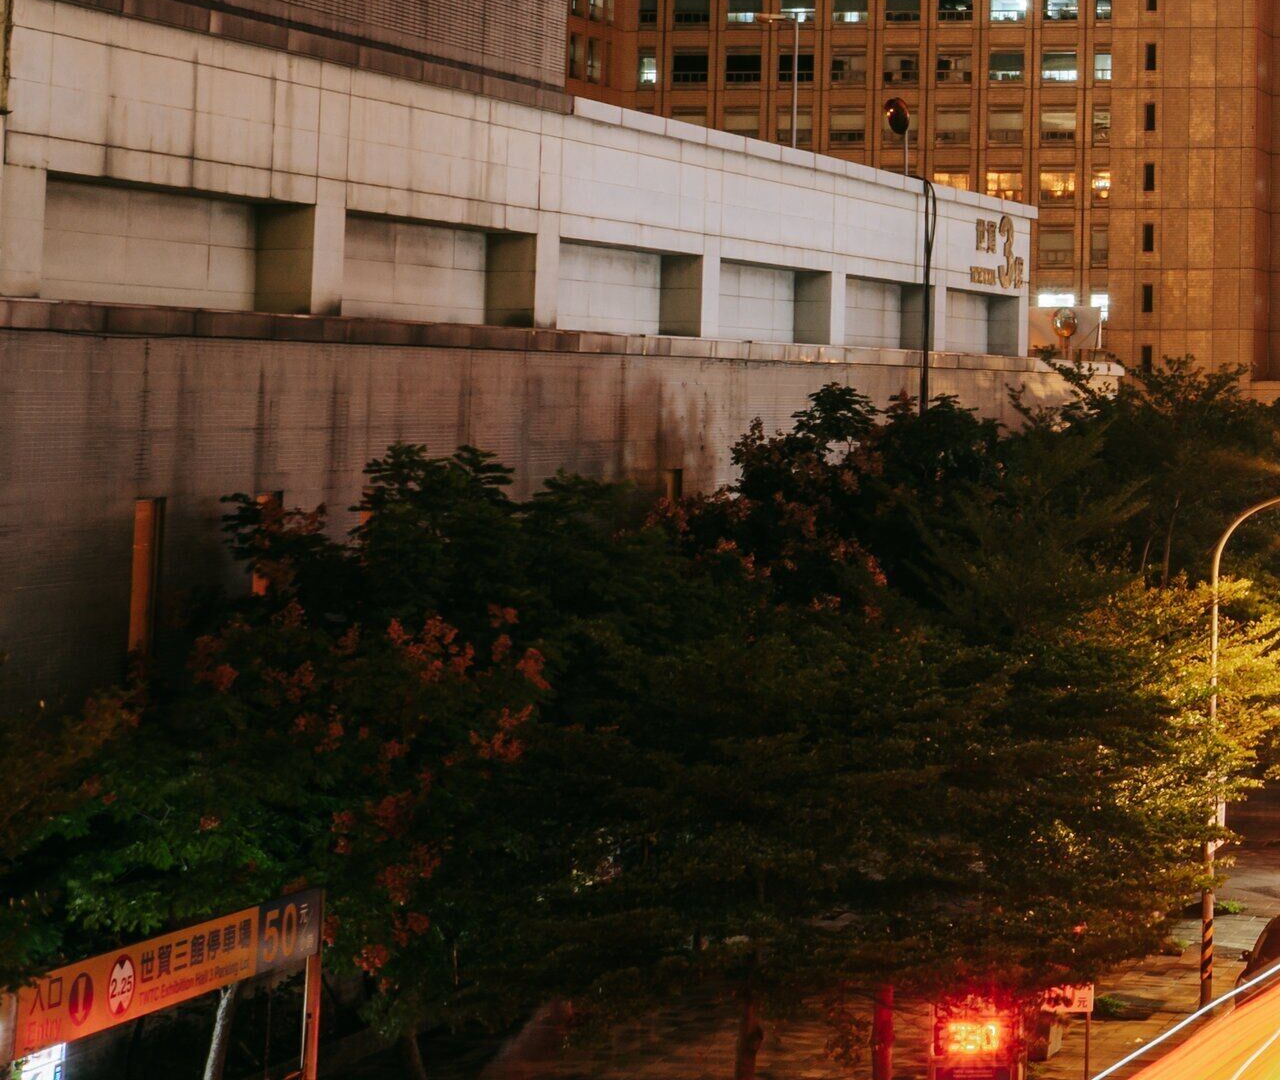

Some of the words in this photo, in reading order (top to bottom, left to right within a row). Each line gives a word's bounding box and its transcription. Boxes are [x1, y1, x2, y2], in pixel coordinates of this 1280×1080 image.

[262, 903, 298, 962] 50
[110, 975, 132, 999] 2.25
[25, 1016, 62, 1046] Entry
